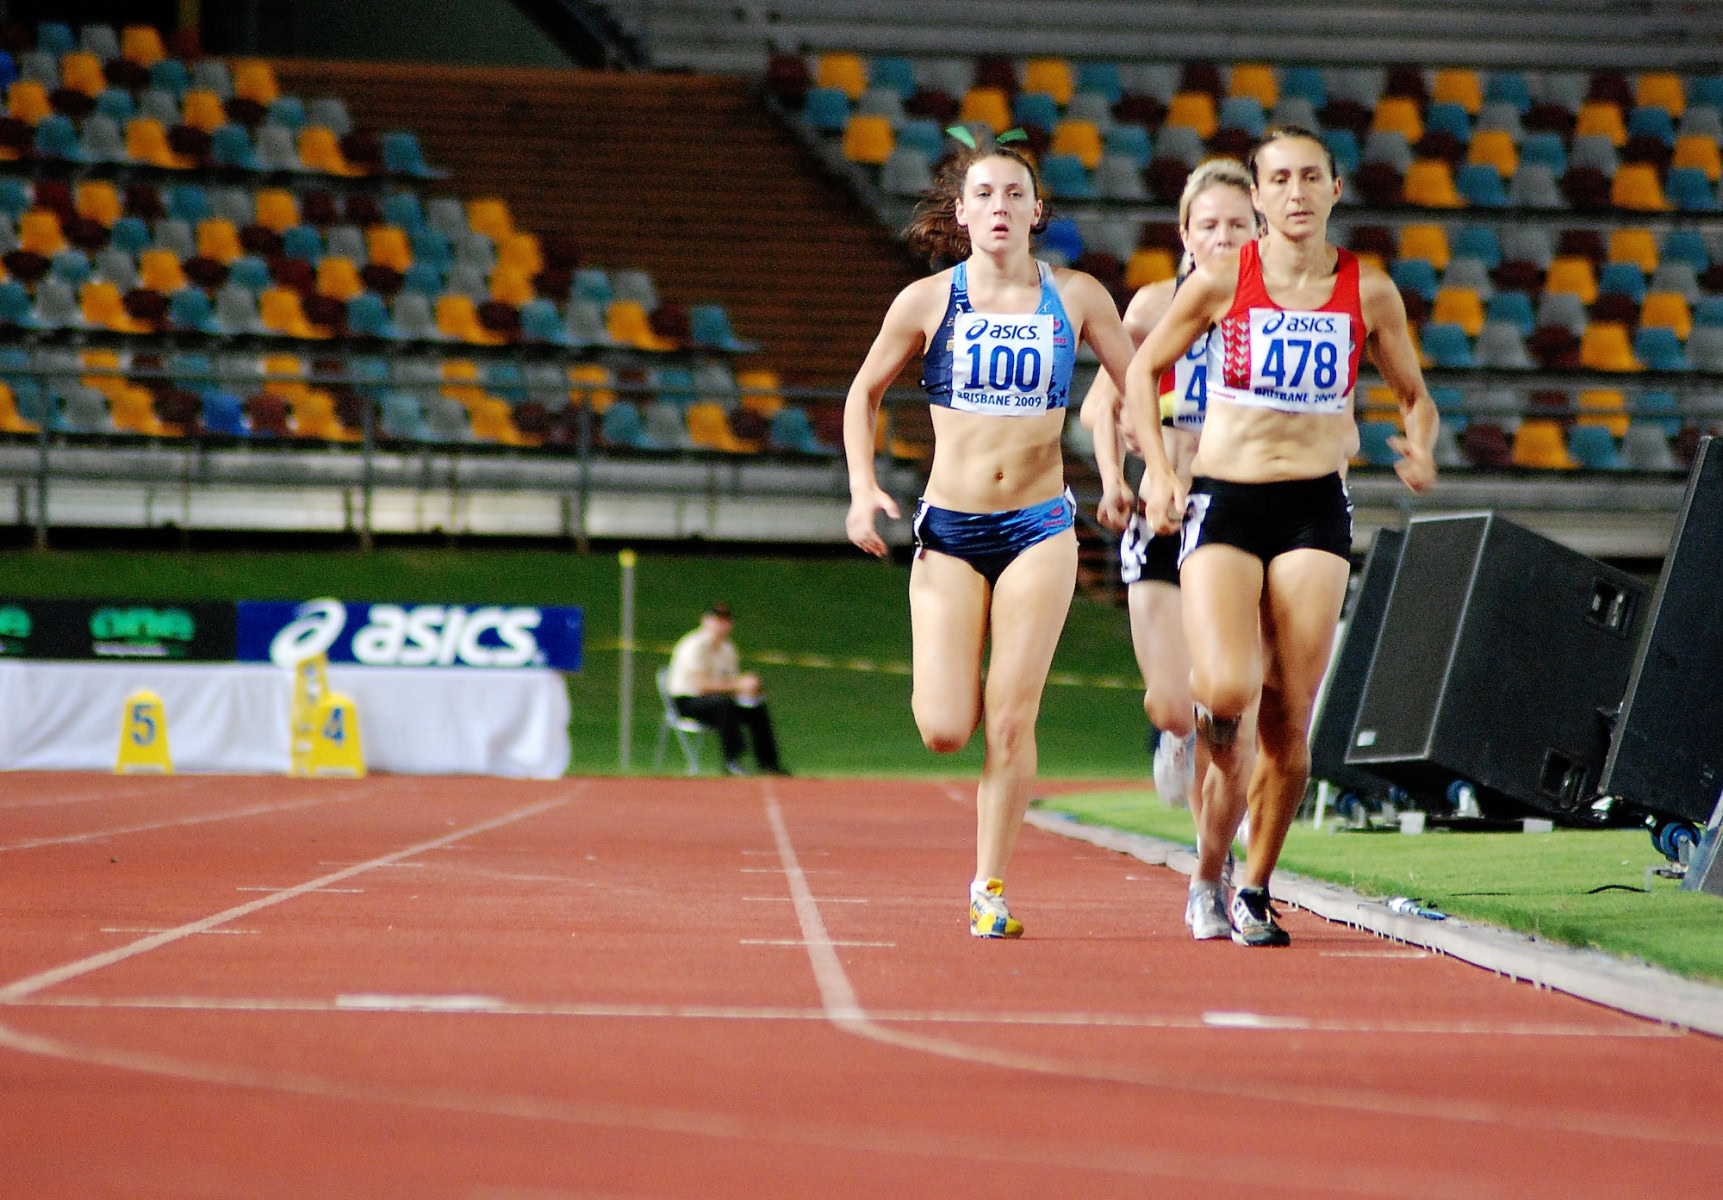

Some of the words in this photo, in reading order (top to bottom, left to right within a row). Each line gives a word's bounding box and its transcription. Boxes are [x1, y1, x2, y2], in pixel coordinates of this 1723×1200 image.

[964, 343, 1041, 393] 100
[1261, 338, 1338, 390] 478
[1015, 396, 1042, 408] 2009
[131, 703, 156, 746] 5
[323, 706, 346, 748] 4
